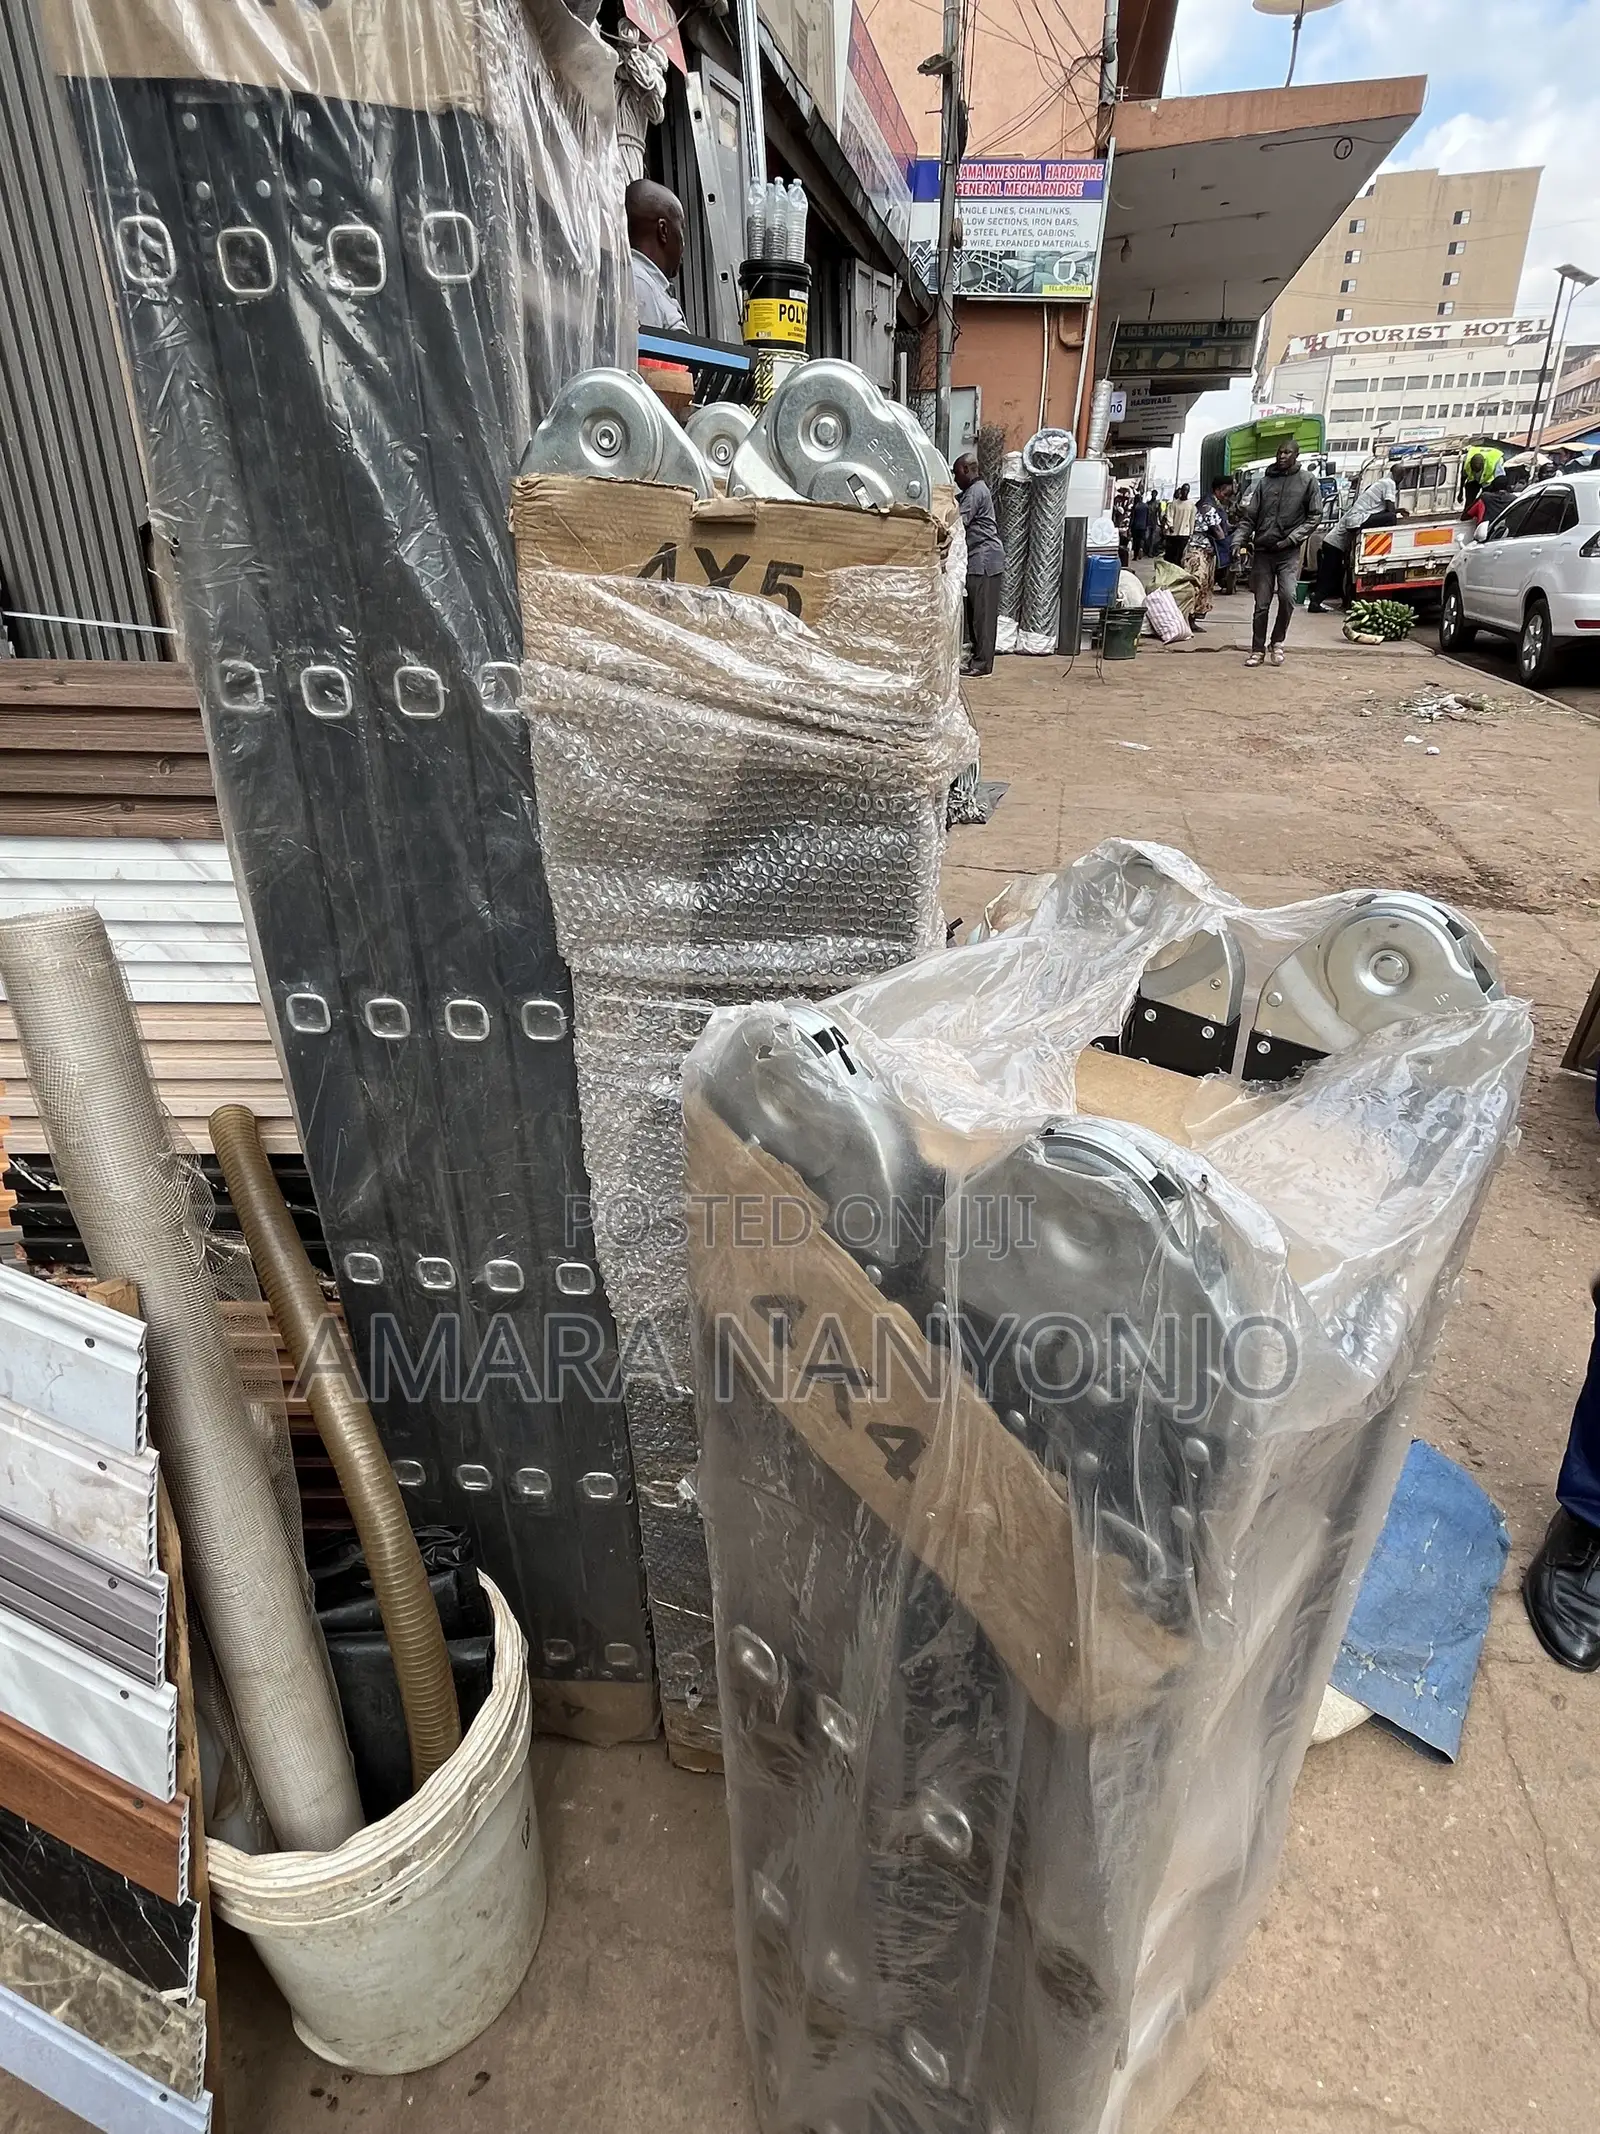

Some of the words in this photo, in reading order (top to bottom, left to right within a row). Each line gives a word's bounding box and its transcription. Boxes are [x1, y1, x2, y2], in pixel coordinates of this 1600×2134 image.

[985, 164, 1041, 180] MWESIGWA
[1045, 164, 1104, 180] HARDWARE
[955, 182, 1003, 197] GENERAL
[1005, 182, 1083, 197] MECHARNDISE
[990, 207, 1016, 216] LINES,
[986, 218, 1030, 227] SECTIONS,
[1031, 218, 1052, 226] IRON
[973, 229, 998, 237] STEEL
[995, 240, 1040, 248] EXPANDED
[1147, 323, 1209, 336] HARDWARE
[1231, 323, 1252, 335] LTD
[1339, 323, 1451, 345] TOURIST
[1462, 317, 1552, 337] HOTEL
